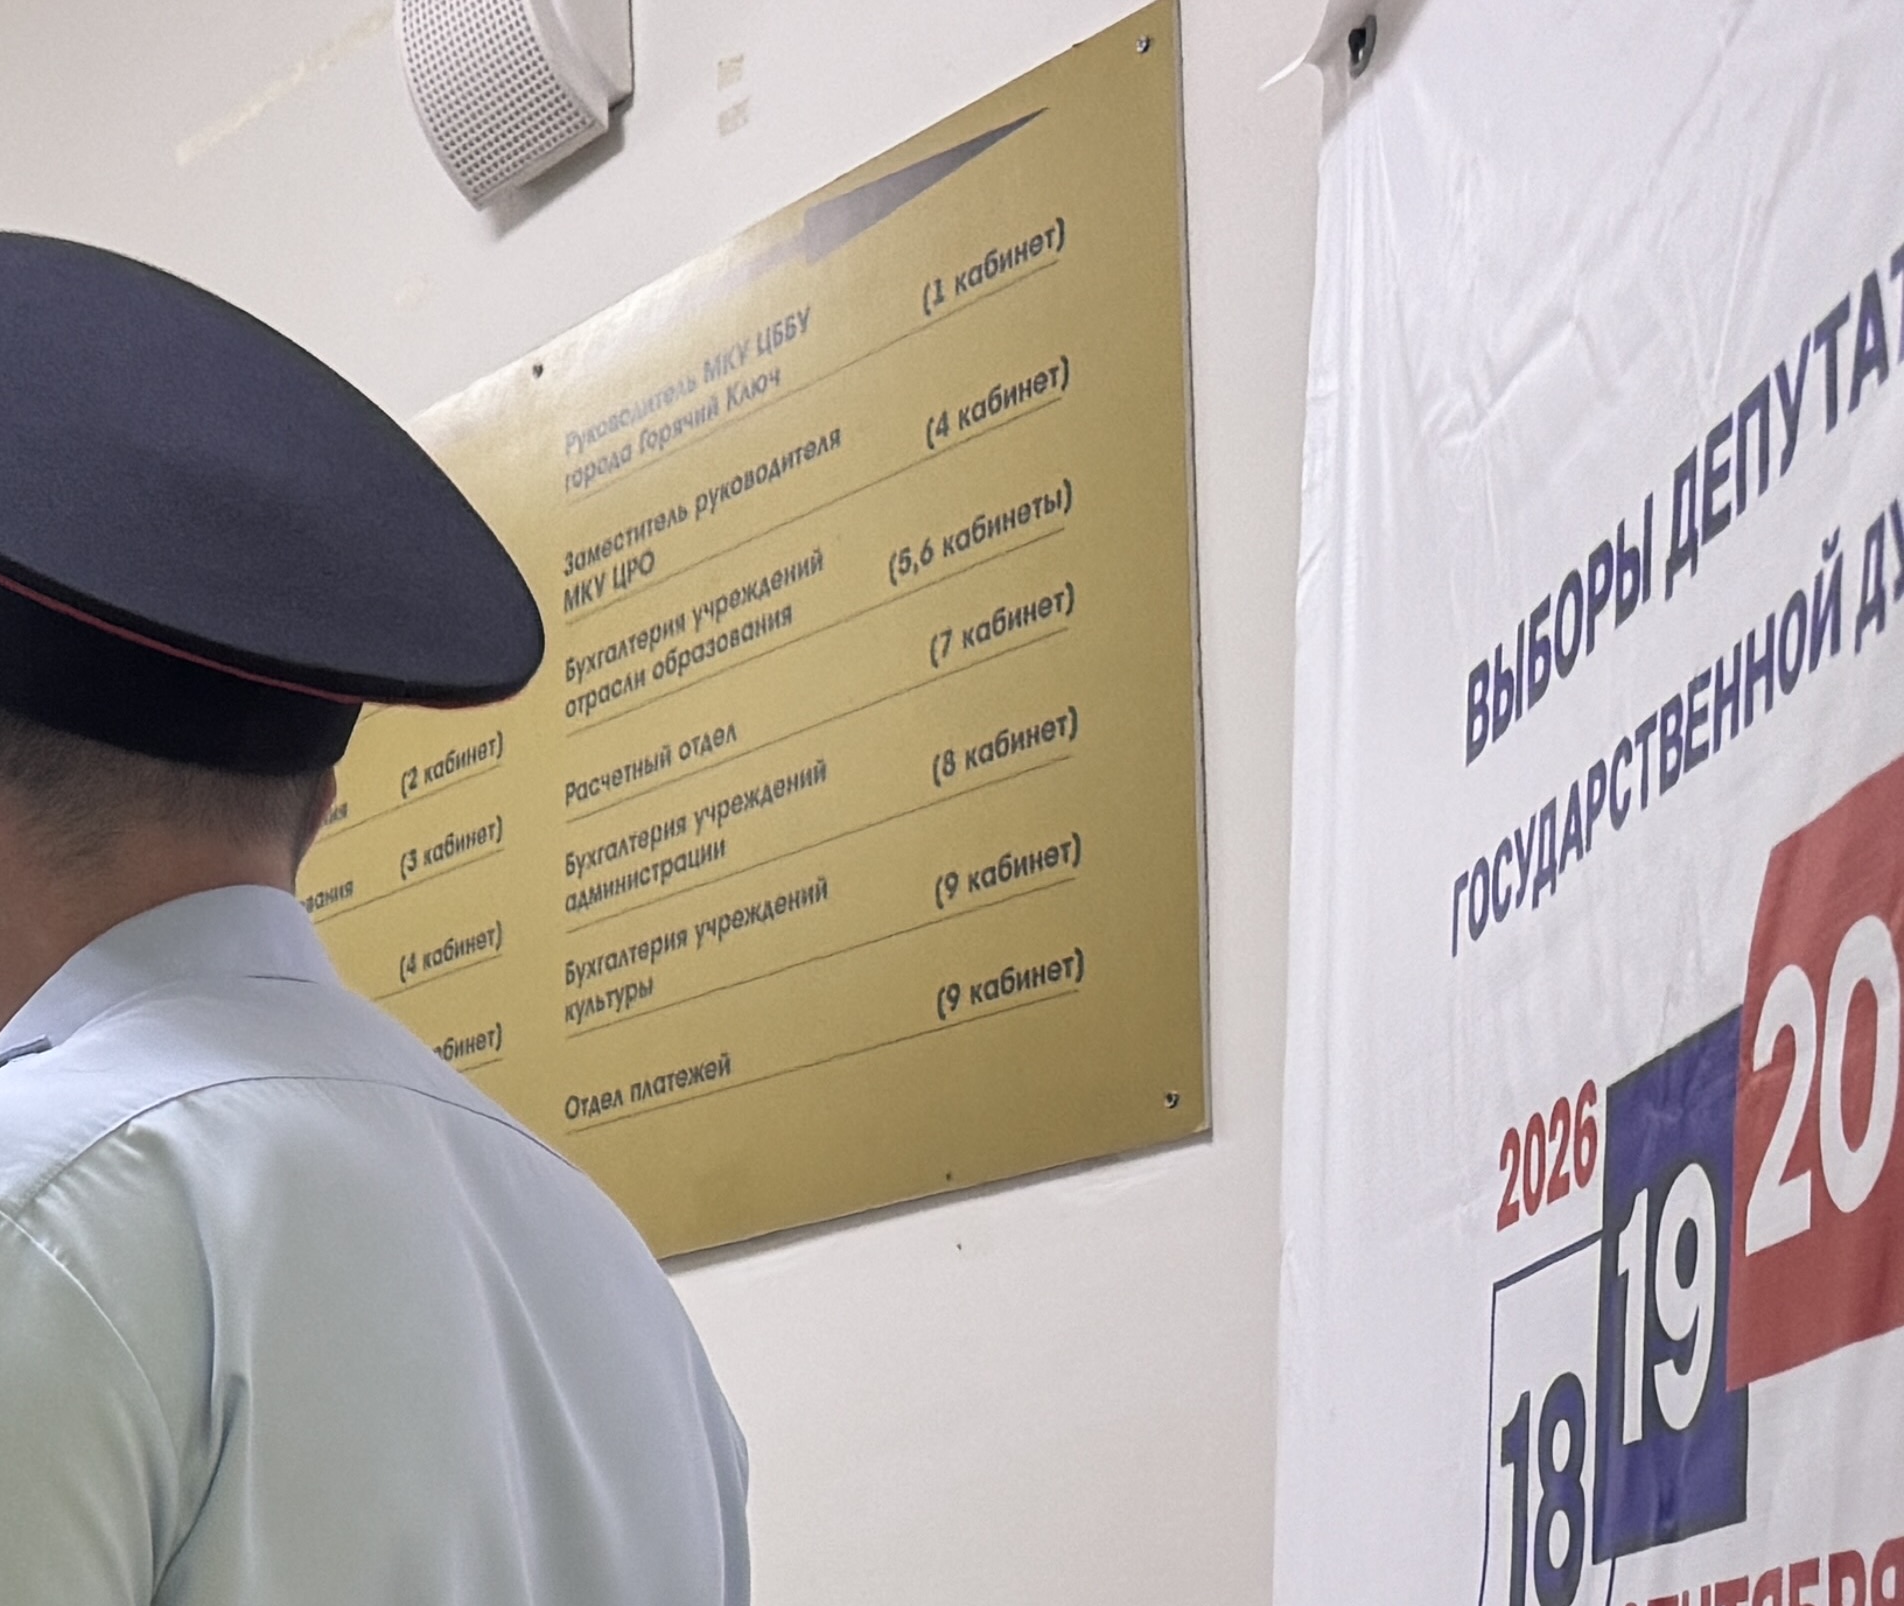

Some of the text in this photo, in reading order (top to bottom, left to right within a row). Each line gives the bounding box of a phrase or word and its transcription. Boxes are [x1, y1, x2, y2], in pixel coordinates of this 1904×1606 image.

[922, 217, 1065, 316] (1 кабинет)
[565, 376, 697, 455] Руководитель
[703, 338, 750, 383] МКУ
[565, 367, 781, 492] города Горячий Ключ
[926, 355, 1069, 449] (4 кабинет)
[563, 428, 841, 577] Заместитель руководителя
[889, 478, 1073, 586] (5,6 кабинеты)
[564, 550, 655, 614] МКУ ЦРО
[565, 547, 824, 683] Бухгалтерия учреждений
[930, 581, 1075, 669] (7 кабинет)
[1465, 490, 1654, 768] ВЫБОРЫ
[565, 605, 792, 717] отрасли образования
[400, 730, 504, 799] (2 кабинет)
[565, 722, 737, 807] Расчетный отдел
[933, 705, 1078, 787] (8 кабинет)
[1451, 525, 1844, 958] ГОСУДАРСТВЕННОЙ
[400, 815, 503, 880] (3 кабинет)
[565, 759, 827, 876] Бухгалтерия учреждений
[565, 838, 726, 913] администрации
[936, 831, 1082, 910] (9 кабинет)
[399, 920, 503, 983] (4 кабинет)
[565, 876, 828, 985] Бухгалтерия учреждений
[565, 977, 653, 1025] культуры
[937, 947, 1085, 1021] (9 кабинет)
[433, 1021, 503, 1062] бинет)
[565, 1052, 731, 1119] Отдел платежей
[1745, 915, 1902, 1257] 20
[1497, 1079, 1597, 1232] 2026
[1617, 1162, 1717, 1445] 19
